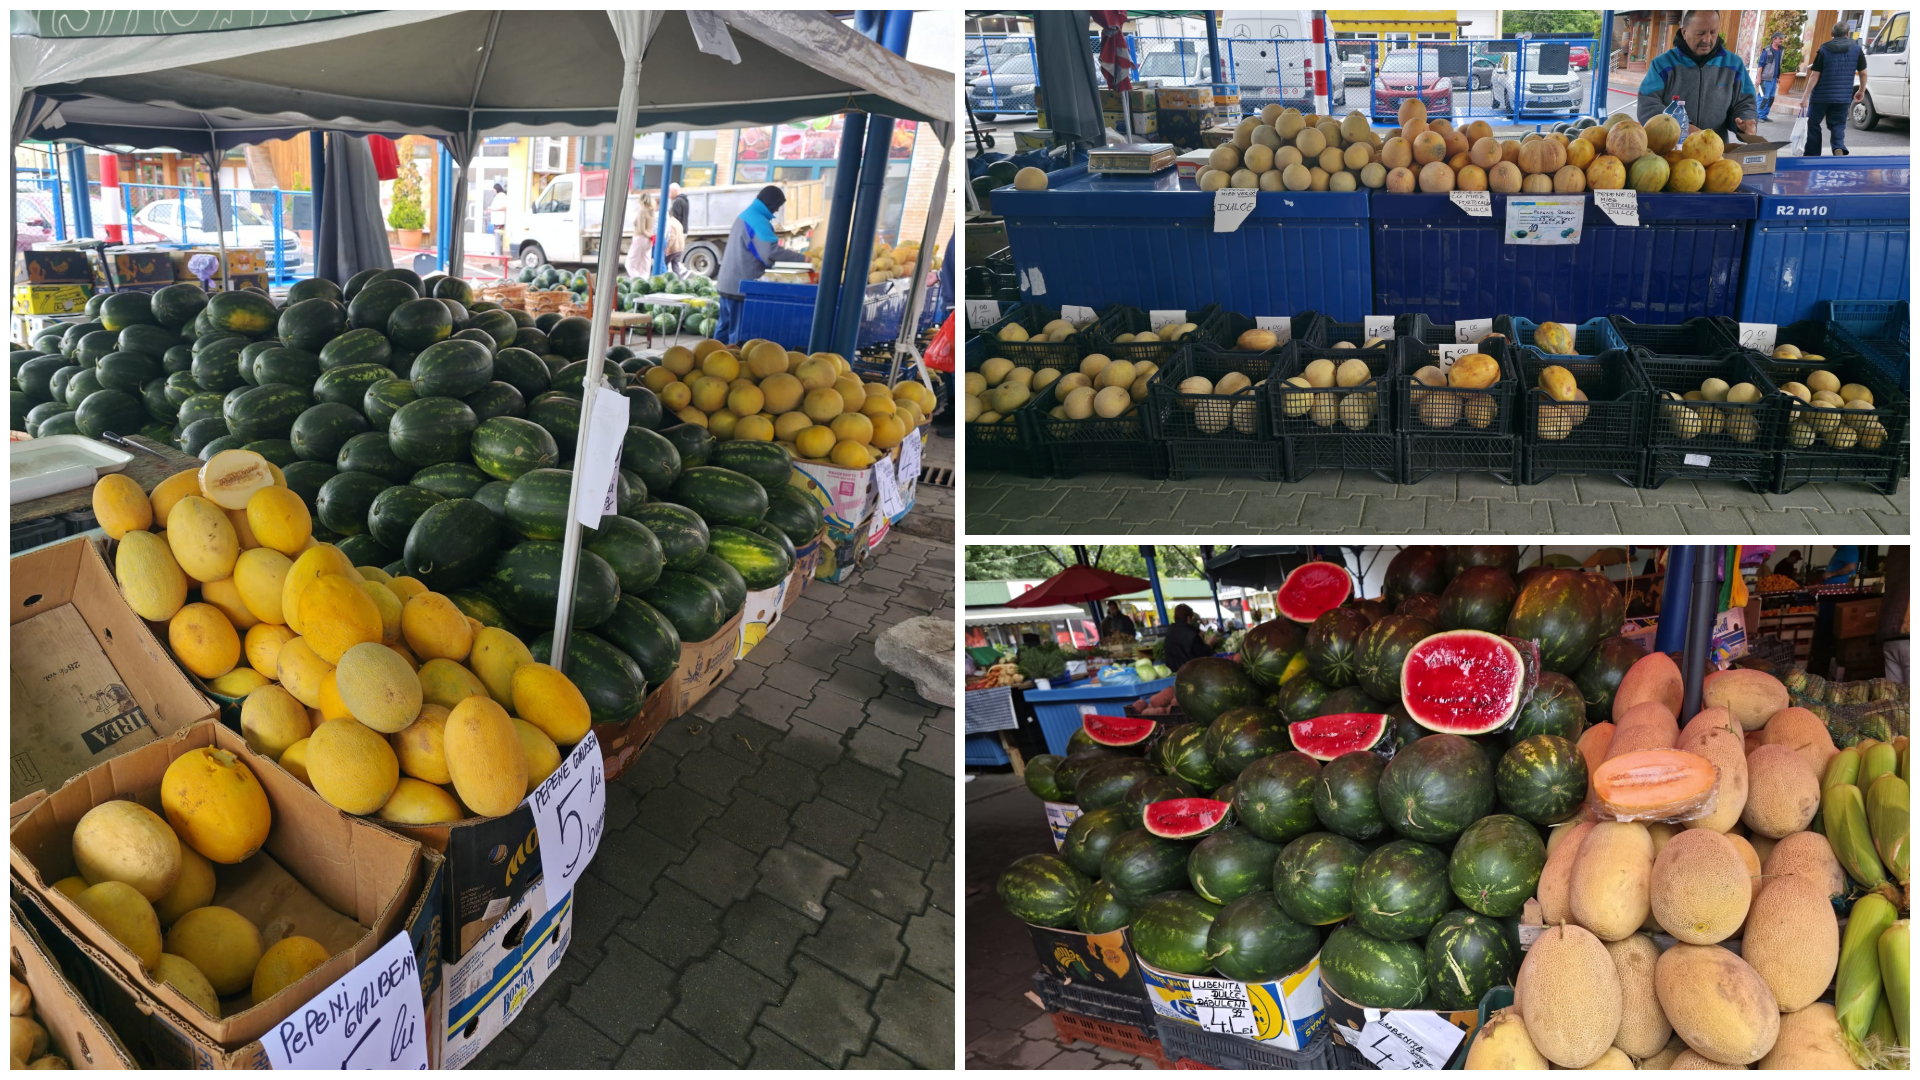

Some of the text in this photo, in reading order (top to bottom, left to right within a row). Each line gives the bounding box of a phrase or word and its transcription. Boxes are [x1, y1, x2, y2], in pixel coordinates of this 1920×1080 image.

[1217, 202, 1254, 212] DULCE
[1776, 206, 1828, 216] R2 m10
[43, 661, 81, 682] 28% vol.
[535, 762, 571, 814] PEPENE
[556, 778, 583, 879] 5
[503, 966, 535, 1017] BONITA
[1192, 979, 1241, 991] LUBENITA
[1370, 1034, 1395, 1065] 4
[1377, 1018, 1425, 1054] LUBENITA
